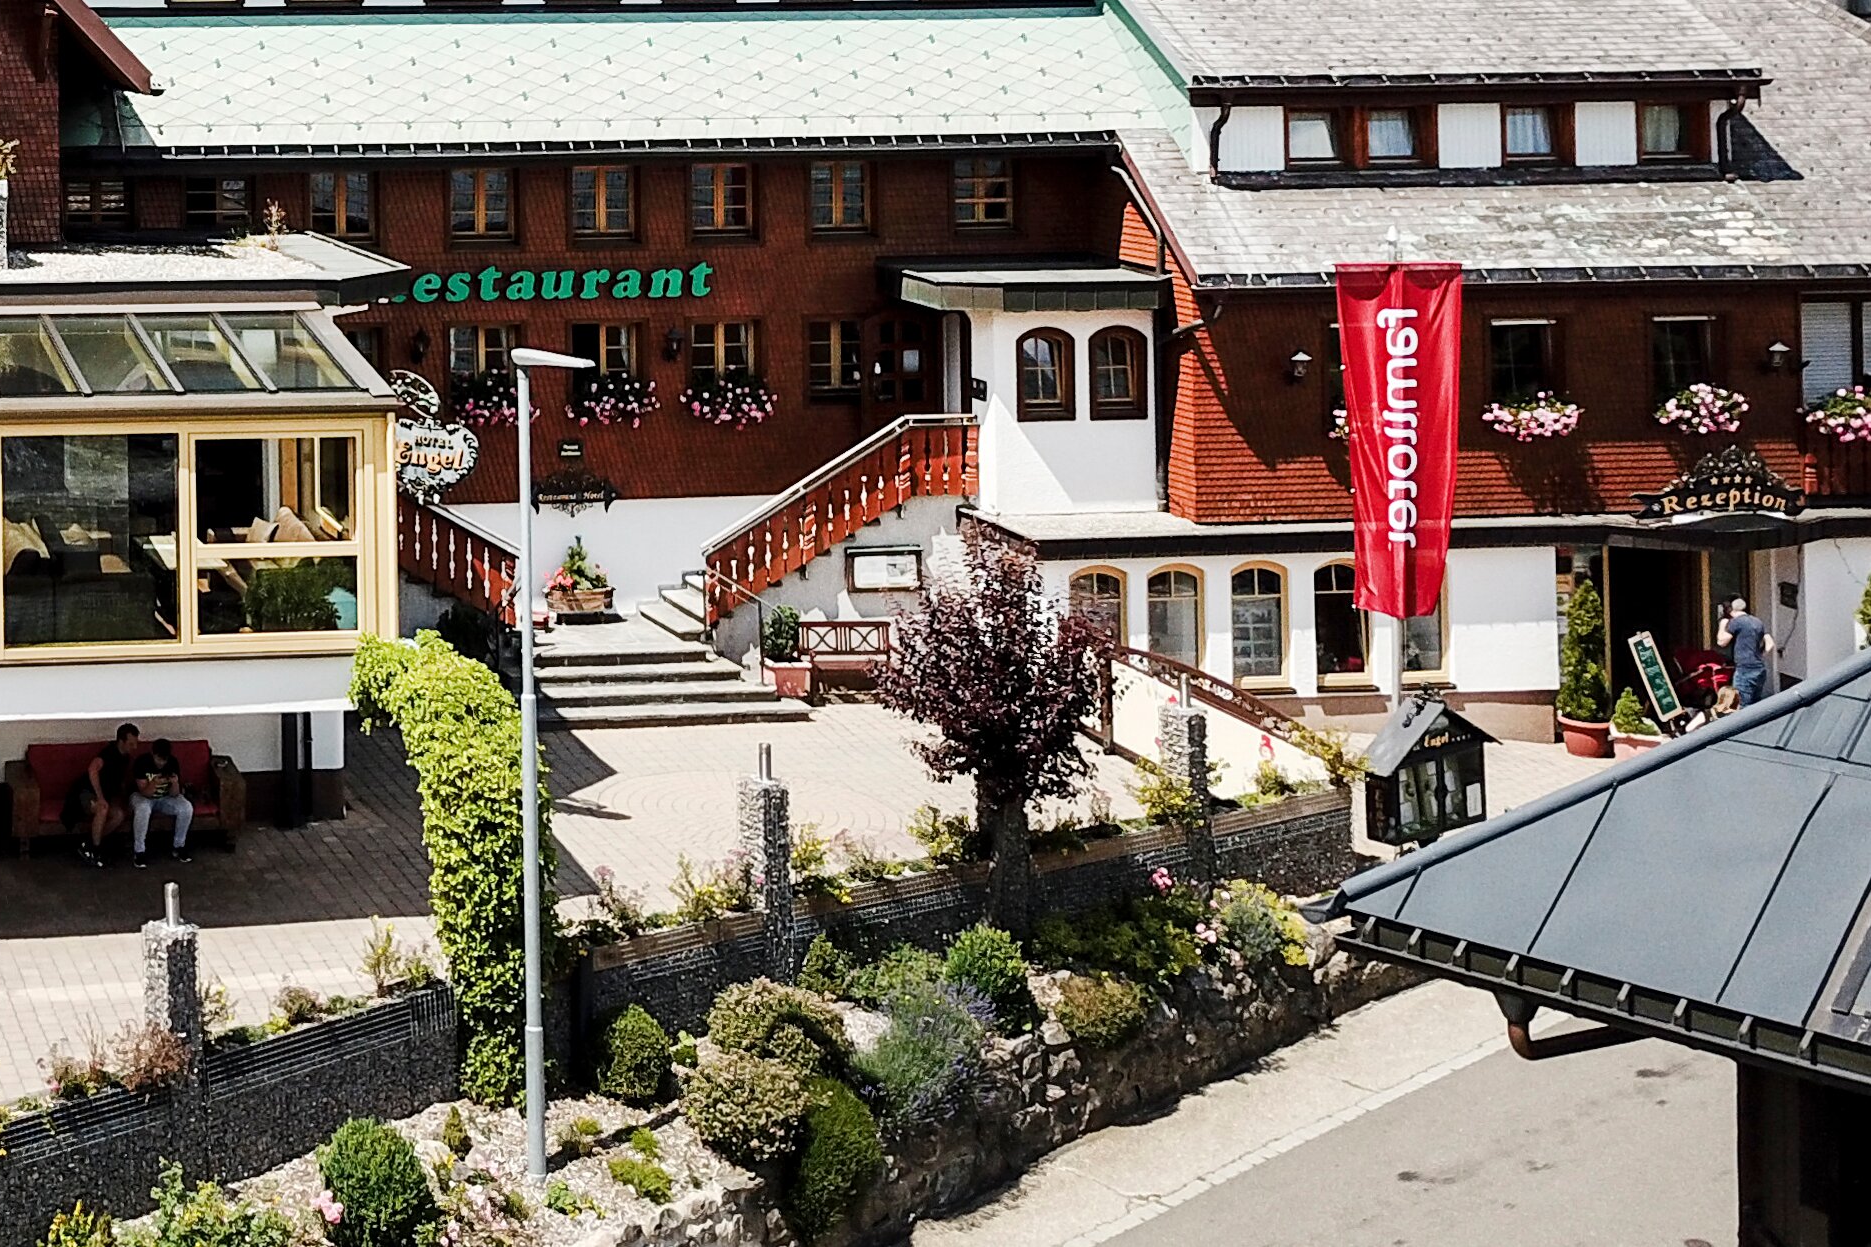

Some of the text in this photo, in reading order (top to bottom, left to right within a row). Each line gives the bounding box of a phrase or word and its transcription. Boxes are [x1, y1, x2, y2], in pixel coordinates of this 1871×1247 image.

[392, 261, 714, 302] estaurant
[395, 438, 464, 473] Engel
[1660, 487, 1786, 515] Rezeption
[1424, 732, 1449, 748] Engel
